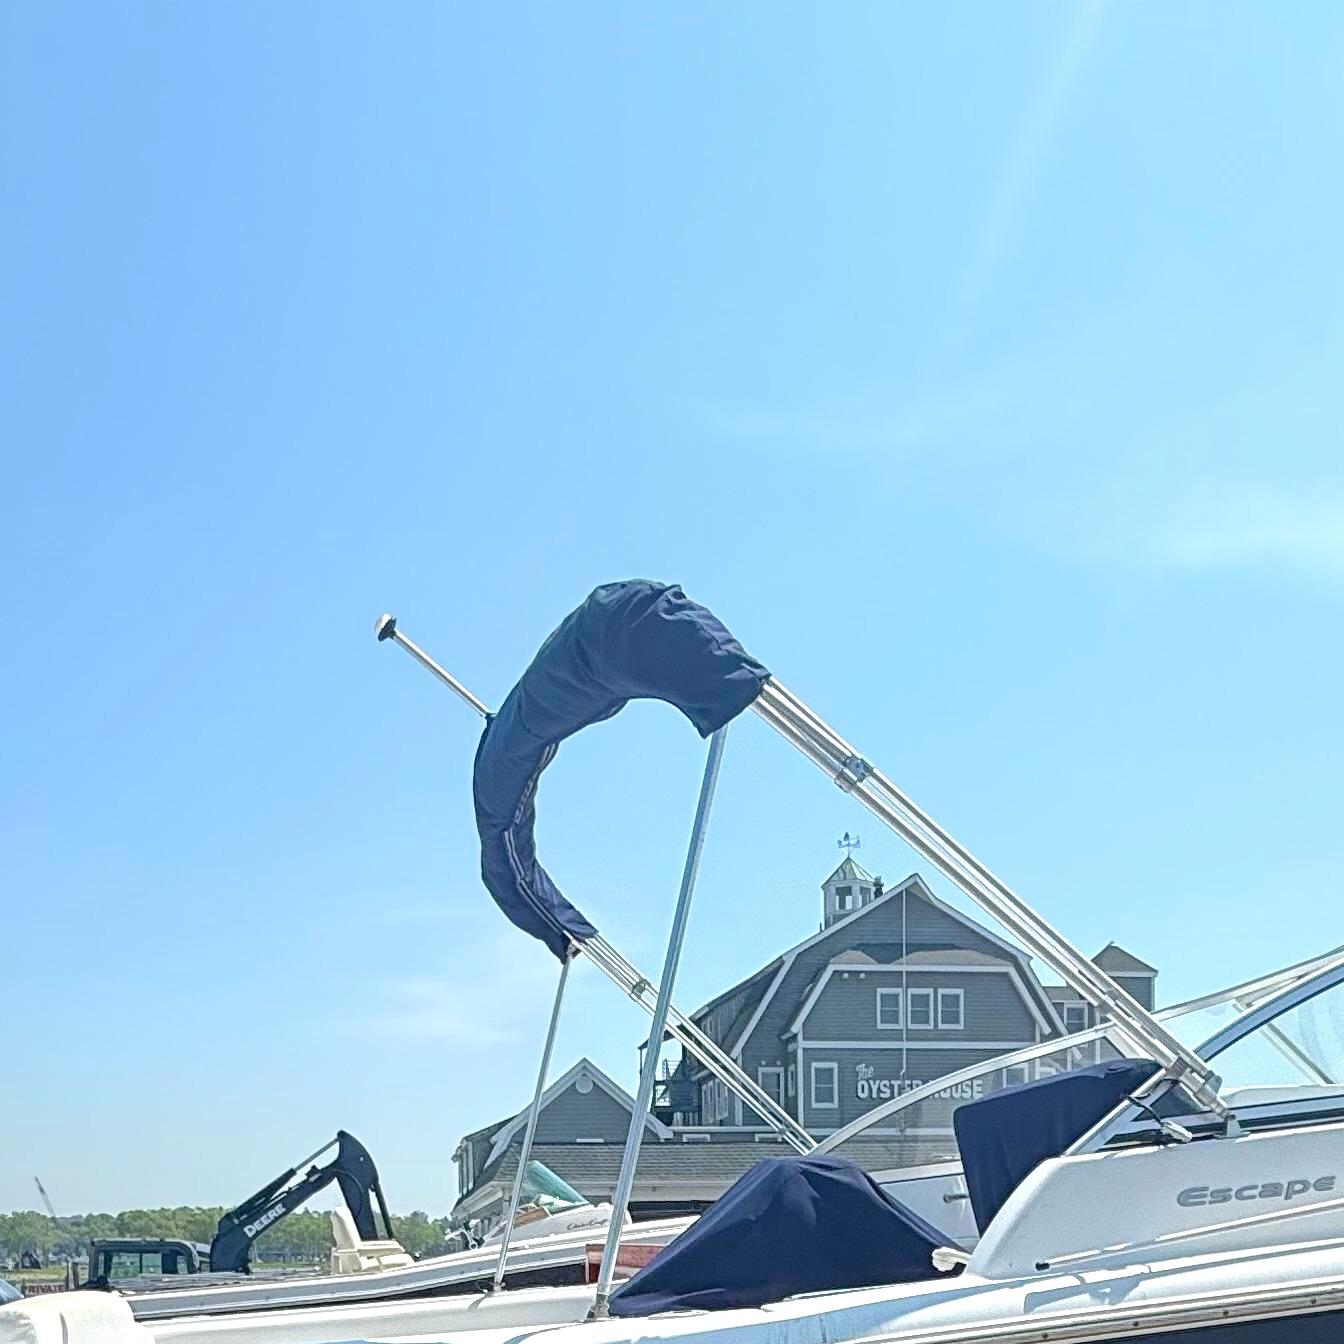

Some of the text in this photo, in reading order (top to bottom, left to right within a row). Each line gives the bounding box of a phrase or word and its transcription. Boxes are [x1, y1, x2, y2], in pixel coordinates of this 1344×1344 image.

[856, 1063, 874, 1080] The
[1176, 1175, 1336, 1207] Escape
[243, 1203, 287, 1238] DEERE
[23, 1284, 65, 1294] PRIVATE
